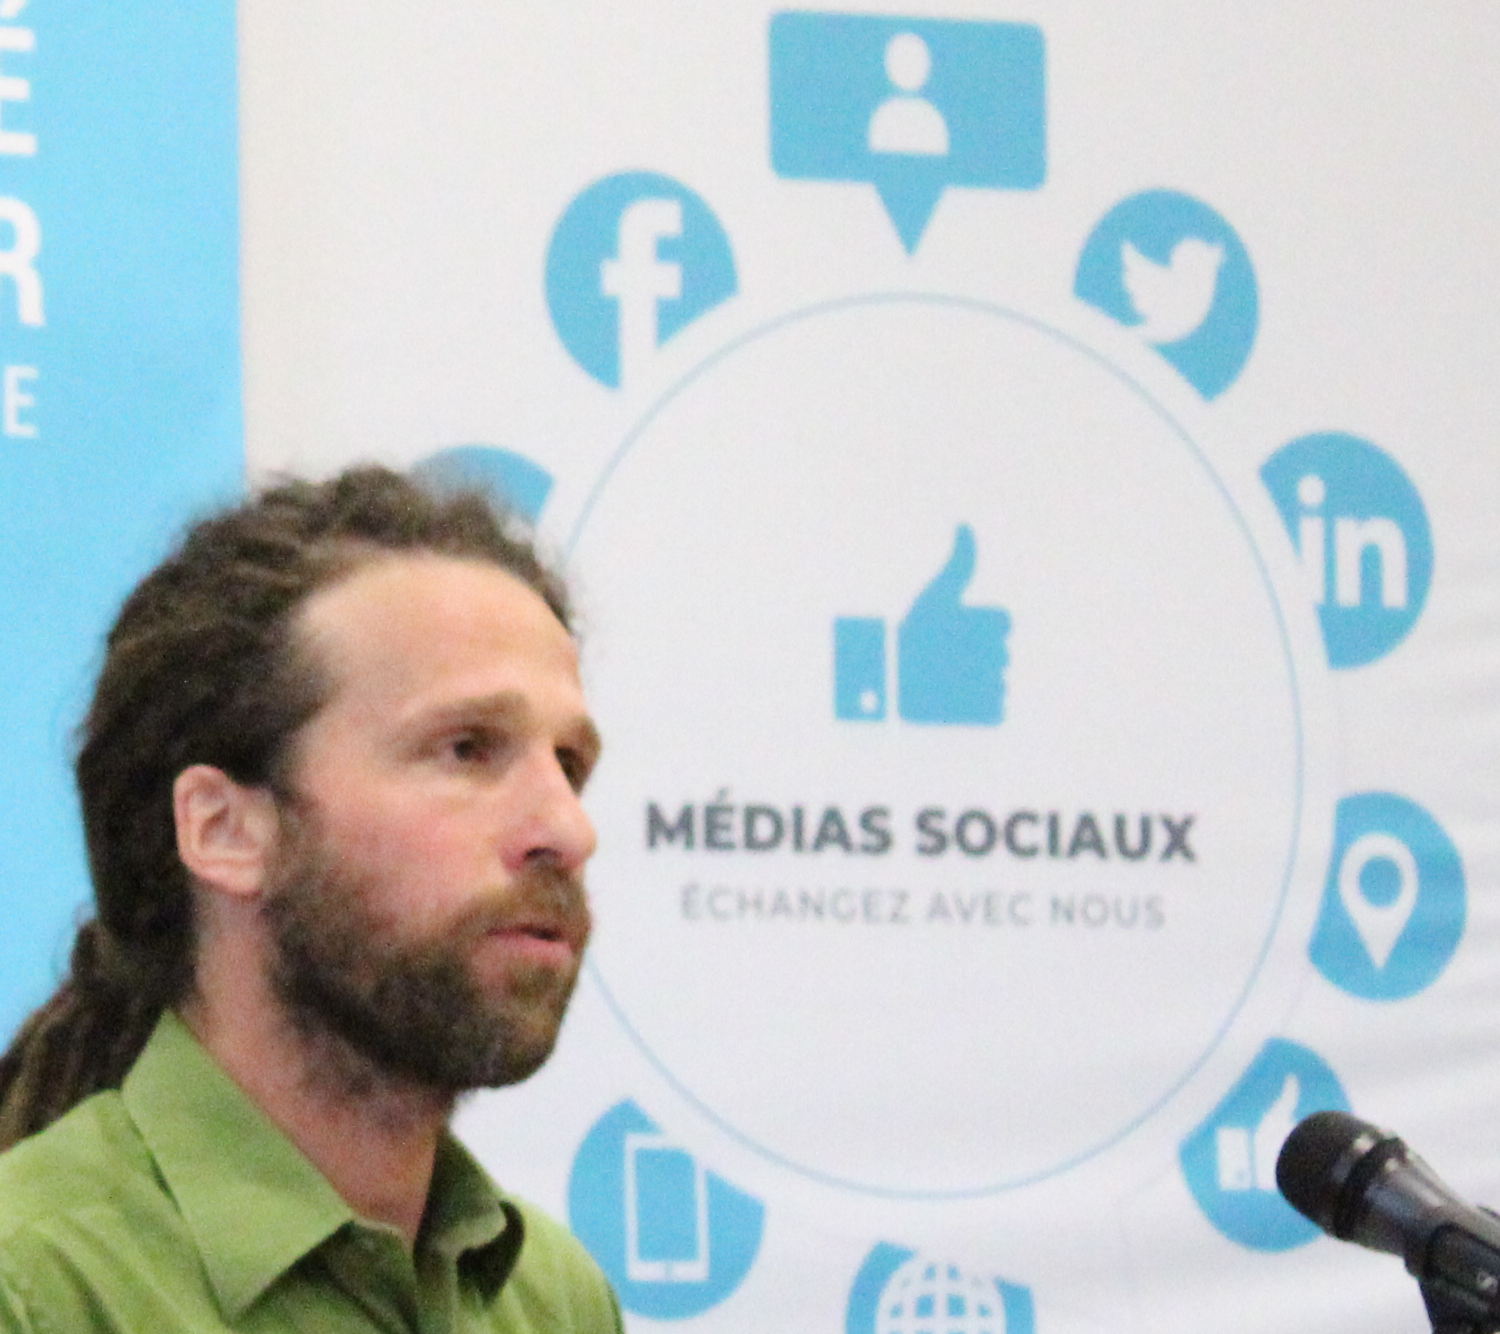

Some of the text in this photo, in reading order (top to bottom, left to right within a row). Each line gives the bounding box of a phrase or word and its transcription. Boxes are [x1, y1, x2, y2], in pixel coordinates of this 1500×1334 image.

[645, 787, 1197, 863] MÉDIAS SOCIAUX
[680, 881, 1167, 931] ÉCHANGEZ AVEC NOUS
